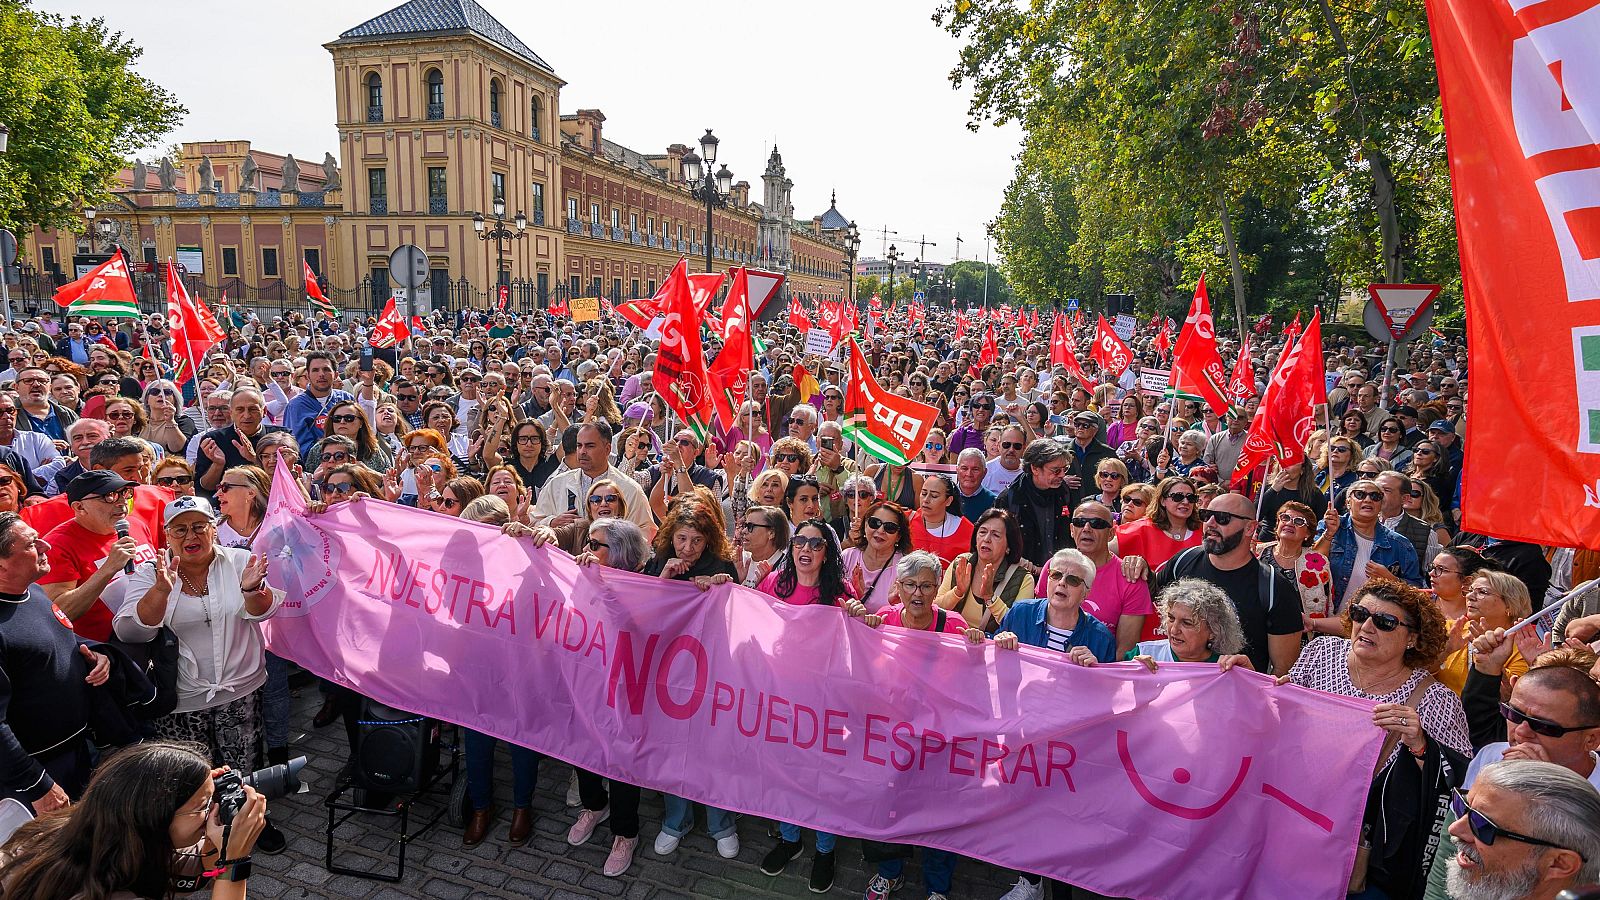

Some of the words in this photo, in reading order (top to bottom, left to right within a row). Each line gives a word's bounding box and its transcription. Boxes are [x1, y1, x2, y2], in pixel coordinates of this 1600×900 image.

[304, 578, 329, 599] Mam
[365, 549, 516, 636] NUESTRA
[532, 592, 607, 667] VIDA
[607, 630, 709, 720] NO
[711, 680, 849, 756] PUEDE
[863, 713, 1077, 793] ESPERAR
